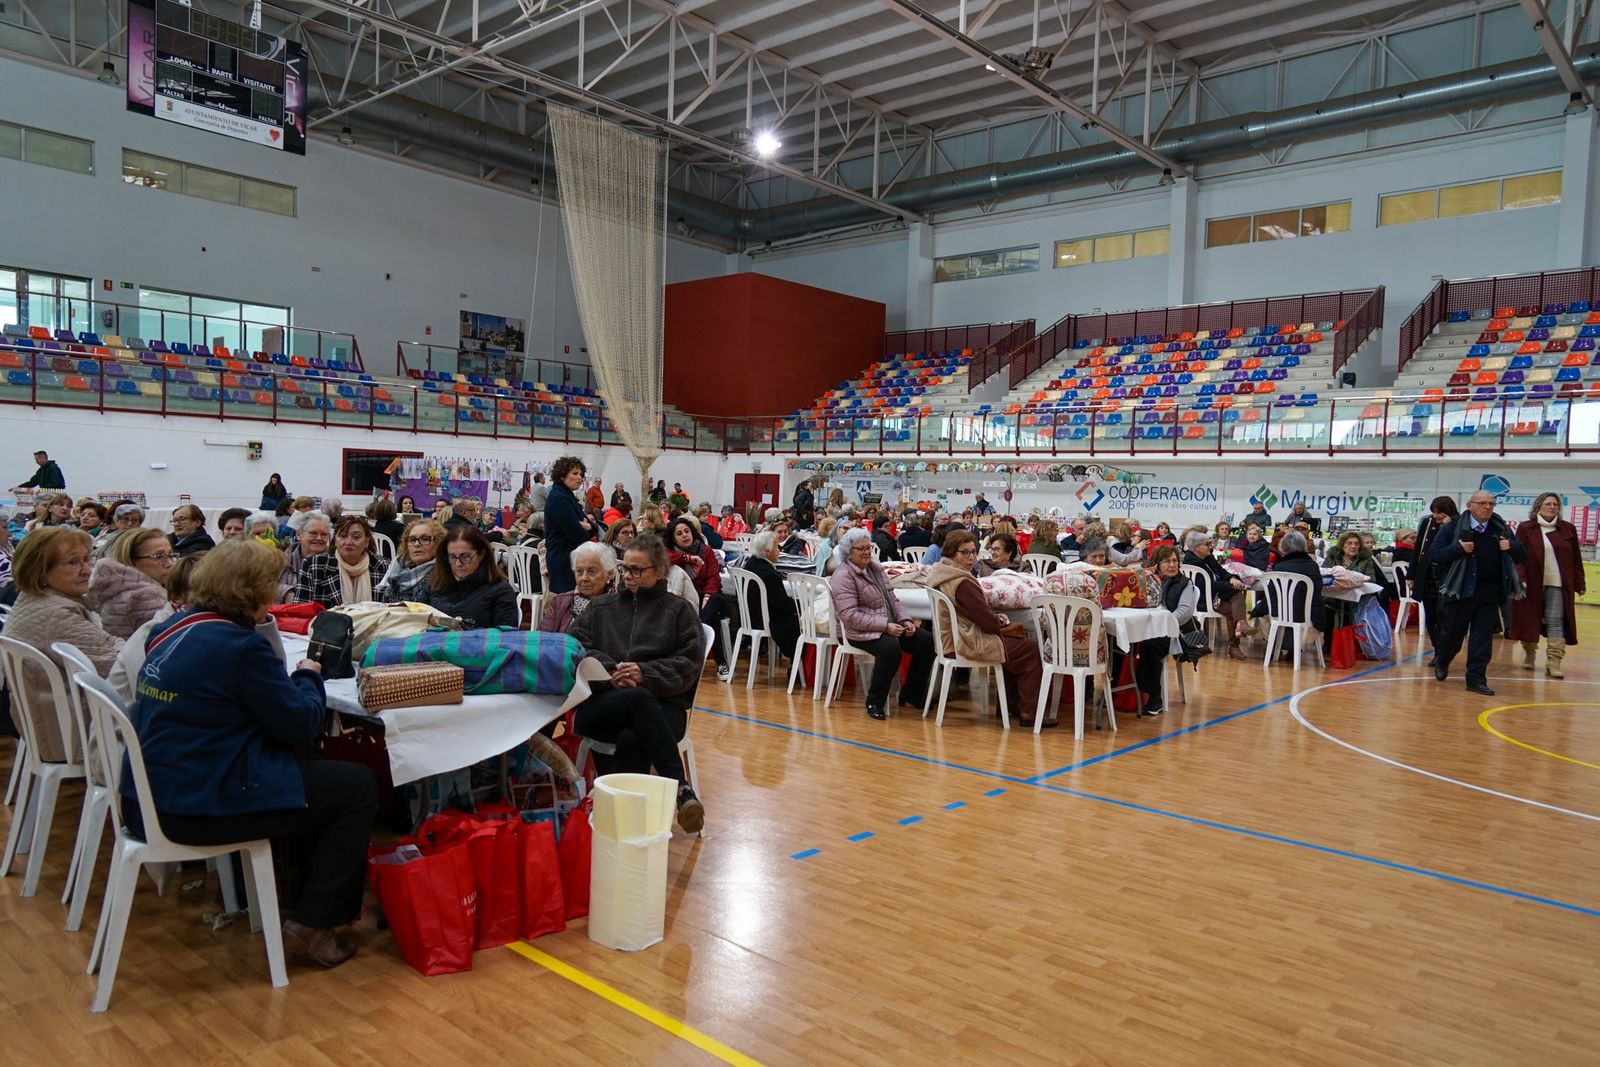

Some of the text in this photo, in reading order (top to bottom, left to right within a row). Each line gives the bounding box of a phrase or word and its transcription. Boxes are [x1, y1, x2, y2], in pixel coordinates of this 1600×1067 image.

[170, 55, 193, 68] LOCAL
[211, 68, 233, 80] PARTE
[243, 78, 276, 92] VISITANTE
[163, 89, 185, 99] FALTAS
[258, 115, 277, 125] FALTAS
[1109, 484, 1217, 501] COOPERACIÓN
[1108, 500, 1136, 510] 2005
[1281, 489, 1424, 516] Murgive
